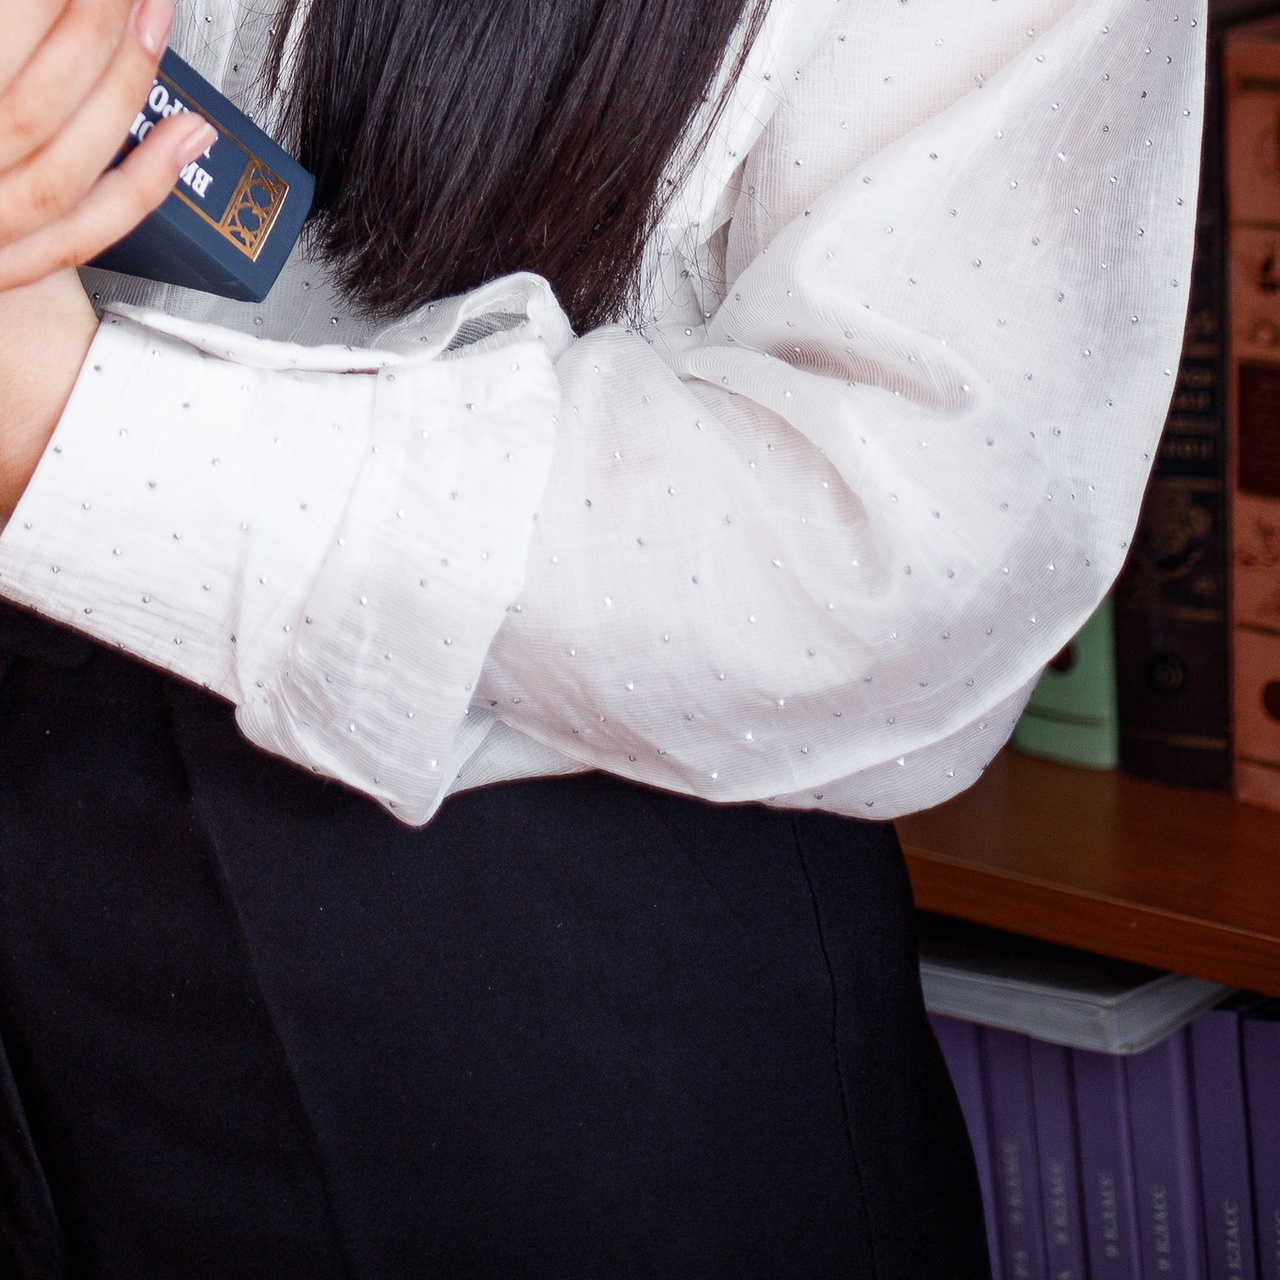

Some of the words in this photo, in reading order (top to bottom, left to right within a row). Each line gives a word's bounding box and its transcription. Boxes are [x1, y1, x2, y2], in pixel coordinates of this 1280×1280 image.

[1097, 1171, 1119, 1240] КЛАСС
[1149, 1185, 1172, 1253] КЛАСС
[1222, 1200, 1243, 1271] КЛАСС
